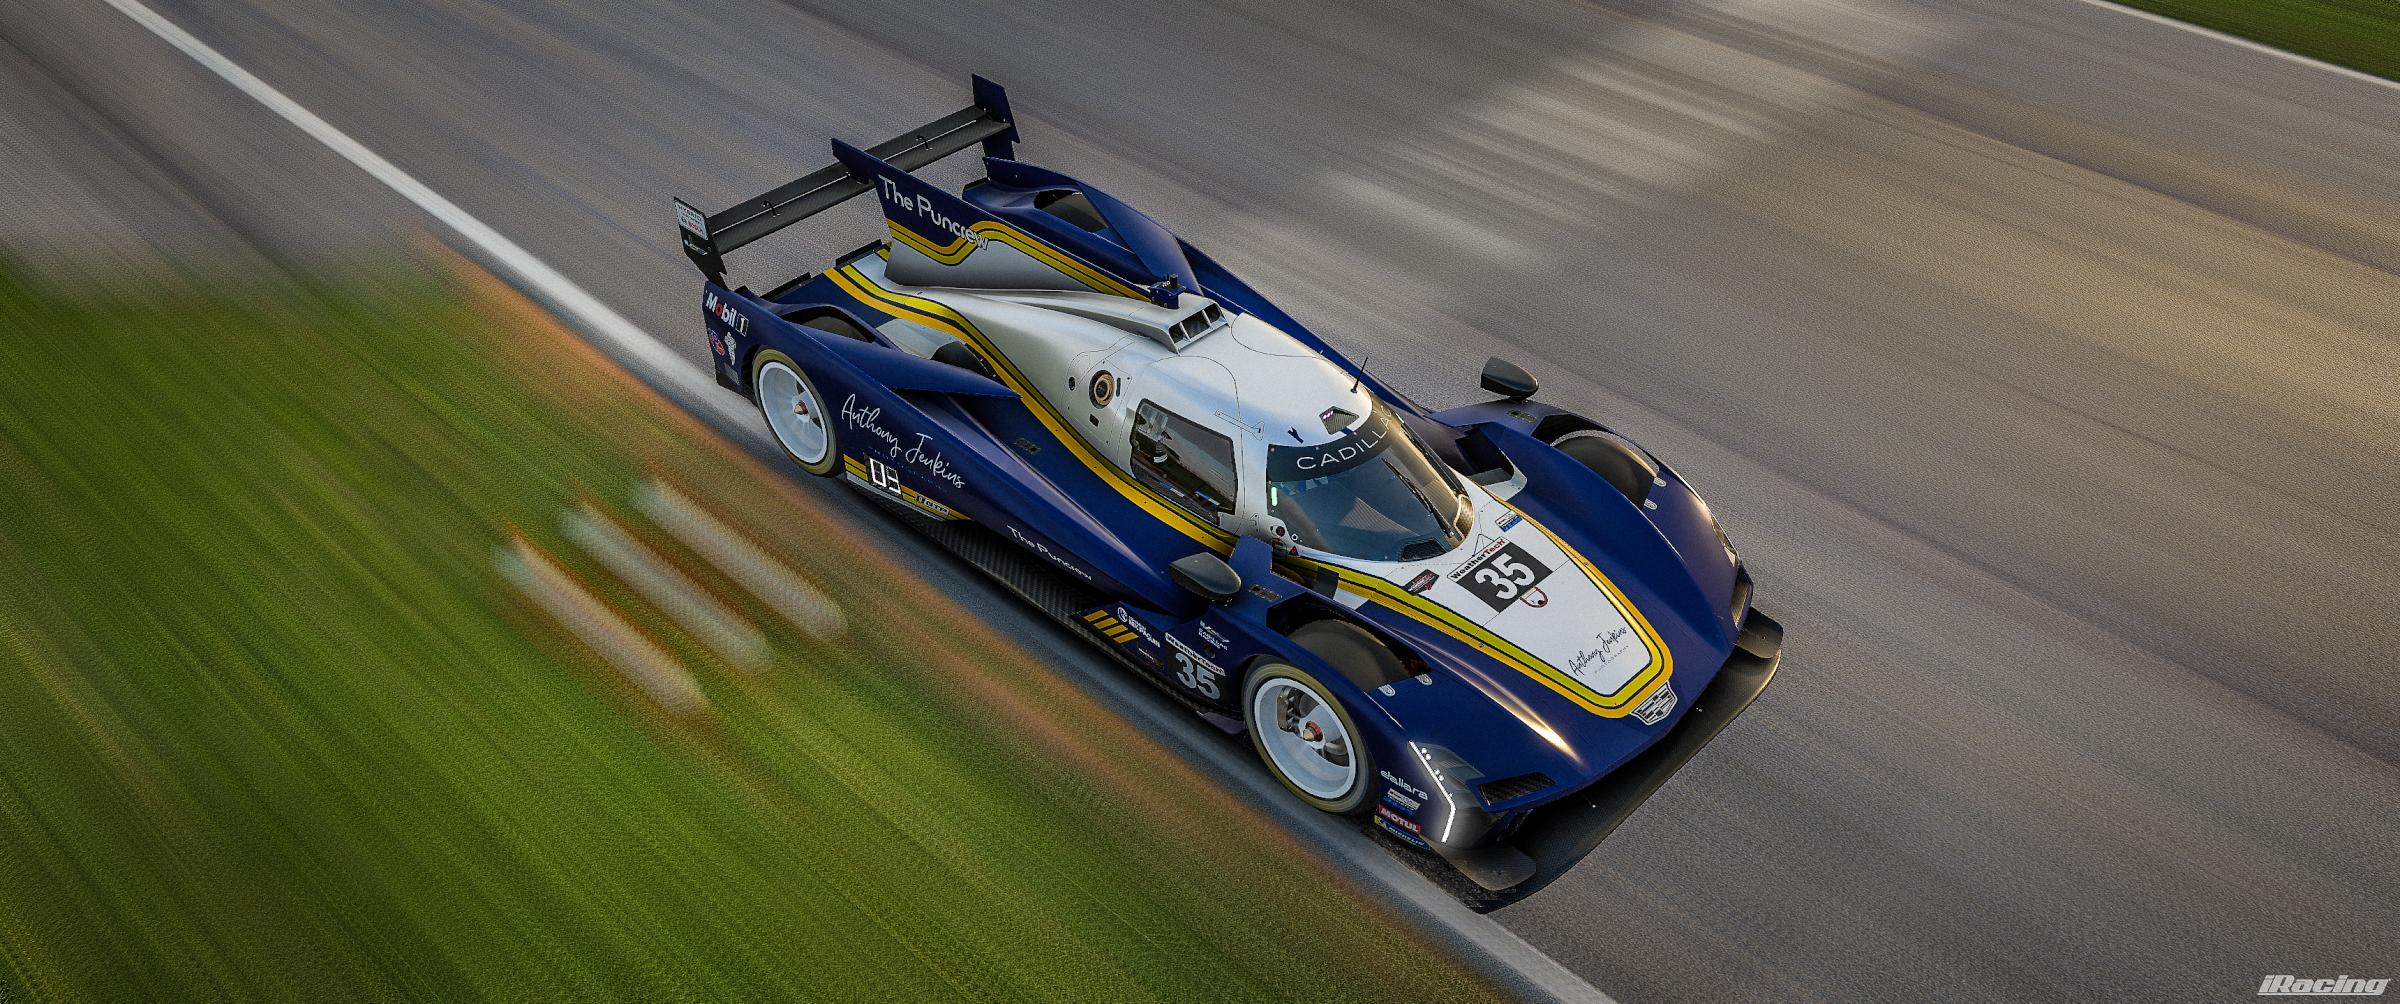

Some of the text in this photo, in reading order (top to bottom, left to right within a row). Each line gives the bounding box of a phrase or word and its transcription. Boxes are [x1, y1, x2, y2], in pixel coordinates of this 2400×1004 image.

[878, 174, 989, 251] The Puncrew
[705, 292, 737, 327] Mobil
[841, 393, 903, 458] Anthony
[905, 432, 966, 490] Jenkins
[1296, 405, 1393, 470] CADILLAC
[1006, 524, 1092, 581] The Puncrew
[1450, 539, 1506, 580] WeatherTech
[1475, 552, 1535, 600] 35
[1175, 652, 1220, 700] 35
[1568, 627, 1627, 677] Anthony Jenkins
[1380, 770, 1429, 800] dallara
[1381, 807, 1419, 833] MOTUL
